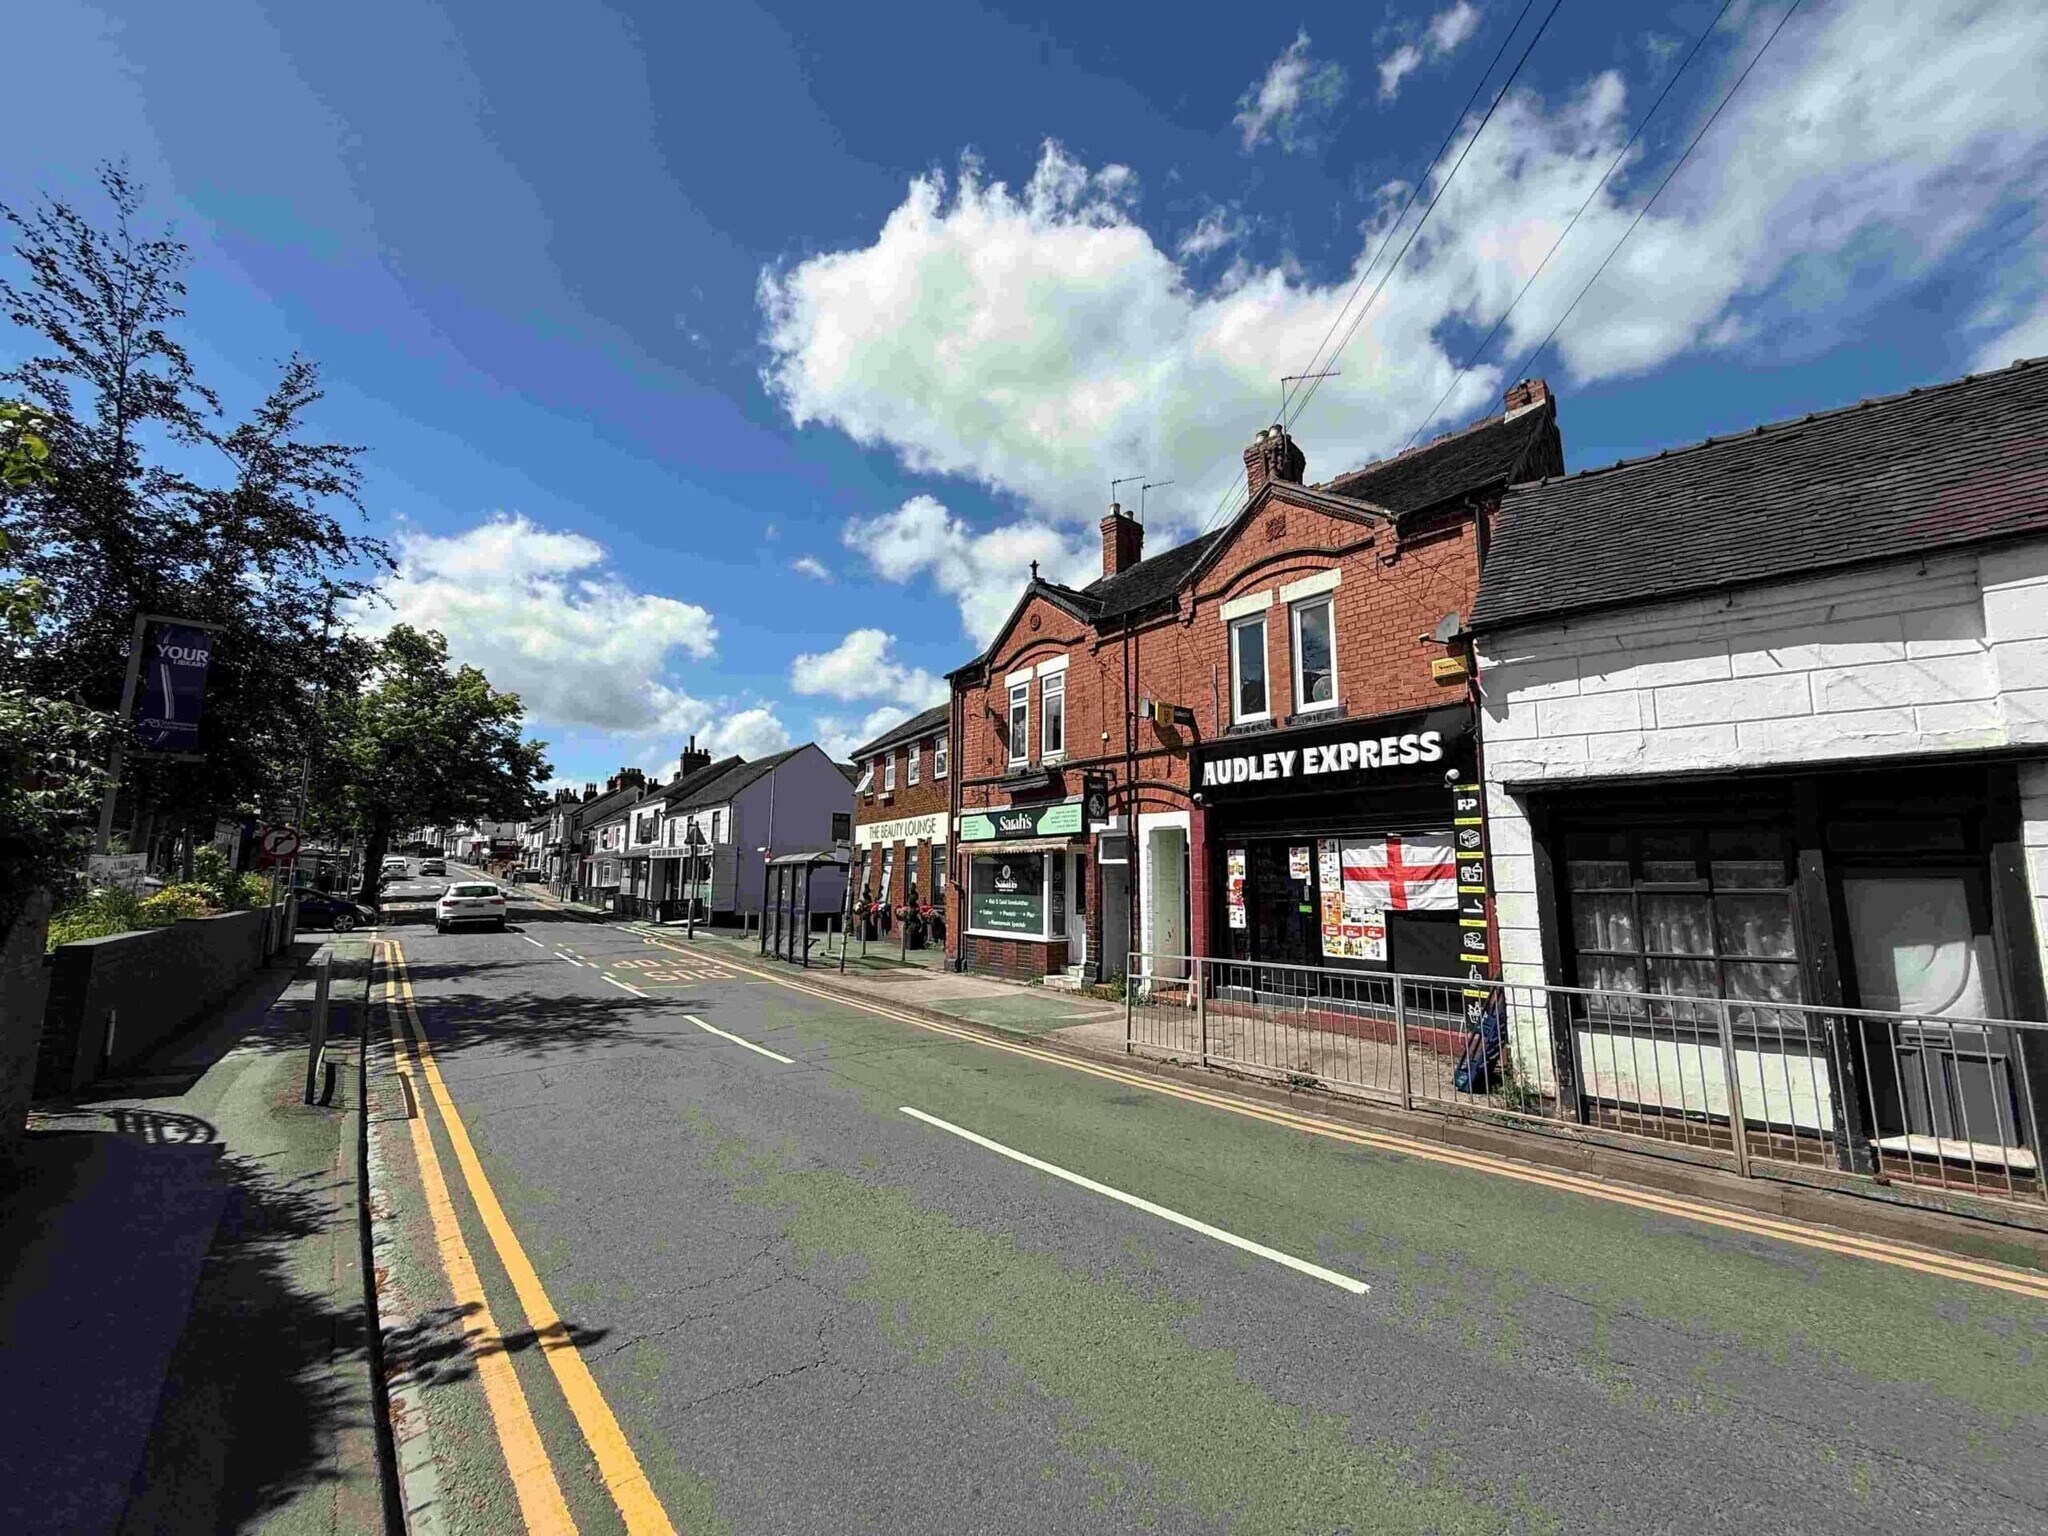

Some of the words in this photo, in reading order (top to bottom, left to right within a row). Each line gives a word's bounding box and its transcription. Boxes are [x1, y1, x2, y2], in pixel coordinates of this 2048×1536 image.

[157, 643, 208, 663] YOUR
[1201, 750, 1297, 786] AUDLEY
[1302, 730, 1443, 775] EXPRESS
[869, 825, 880, 840] THE
[881, 821, 904, 839] BEAUTY
[905, 817, 937, 837] LOUNGE
[999, 812, 1032, 832] Sarah's
[643, 969, 737, 981] BUS
